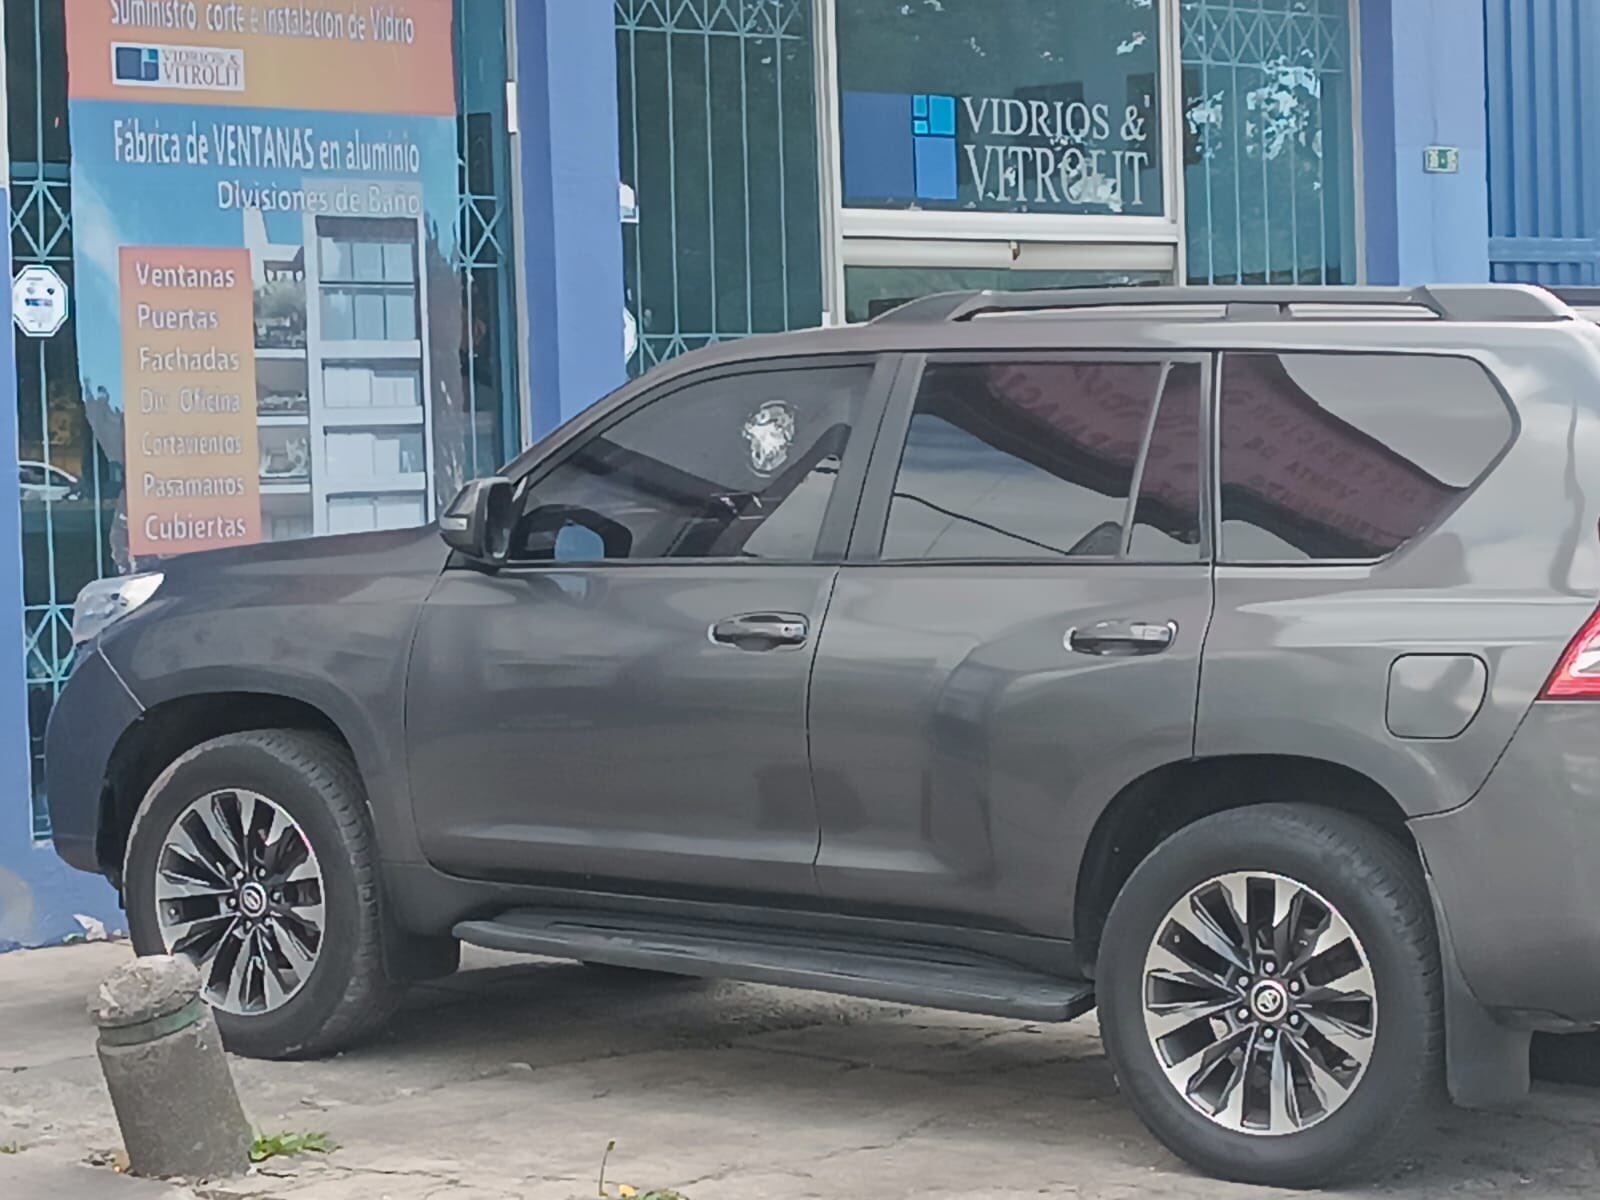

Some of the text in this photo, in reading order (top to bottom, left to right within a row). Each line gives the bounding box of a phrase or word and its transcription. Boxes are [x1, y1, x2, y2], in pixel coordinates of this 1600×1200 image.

[206, 2, 244, 33] corte
[348, 7, 366, 40] de
[369, 5, 415, 44] Vidrio
[163, 62, 240, 86] VITROLIT
[962, 96, 1147, 141] VIDRIOS &
[114, 118, 180, 163] Fábrica
[186, 120, 208, 165] de
[212, 124, 315, 170] VENTANAS
[319, 139, 341, 170] en
[217, 179, 328, 212] Divisiones
[335, 184, 362, 213] de
[136, 262, 236, 288] Ventanas
[137, 304, 219, 330] Puertas
[139, 346, 240, 372] Fachadas
[144, 473, 245, 498] Pasamanos
[145, 513, 247, 541] Cubiertas
